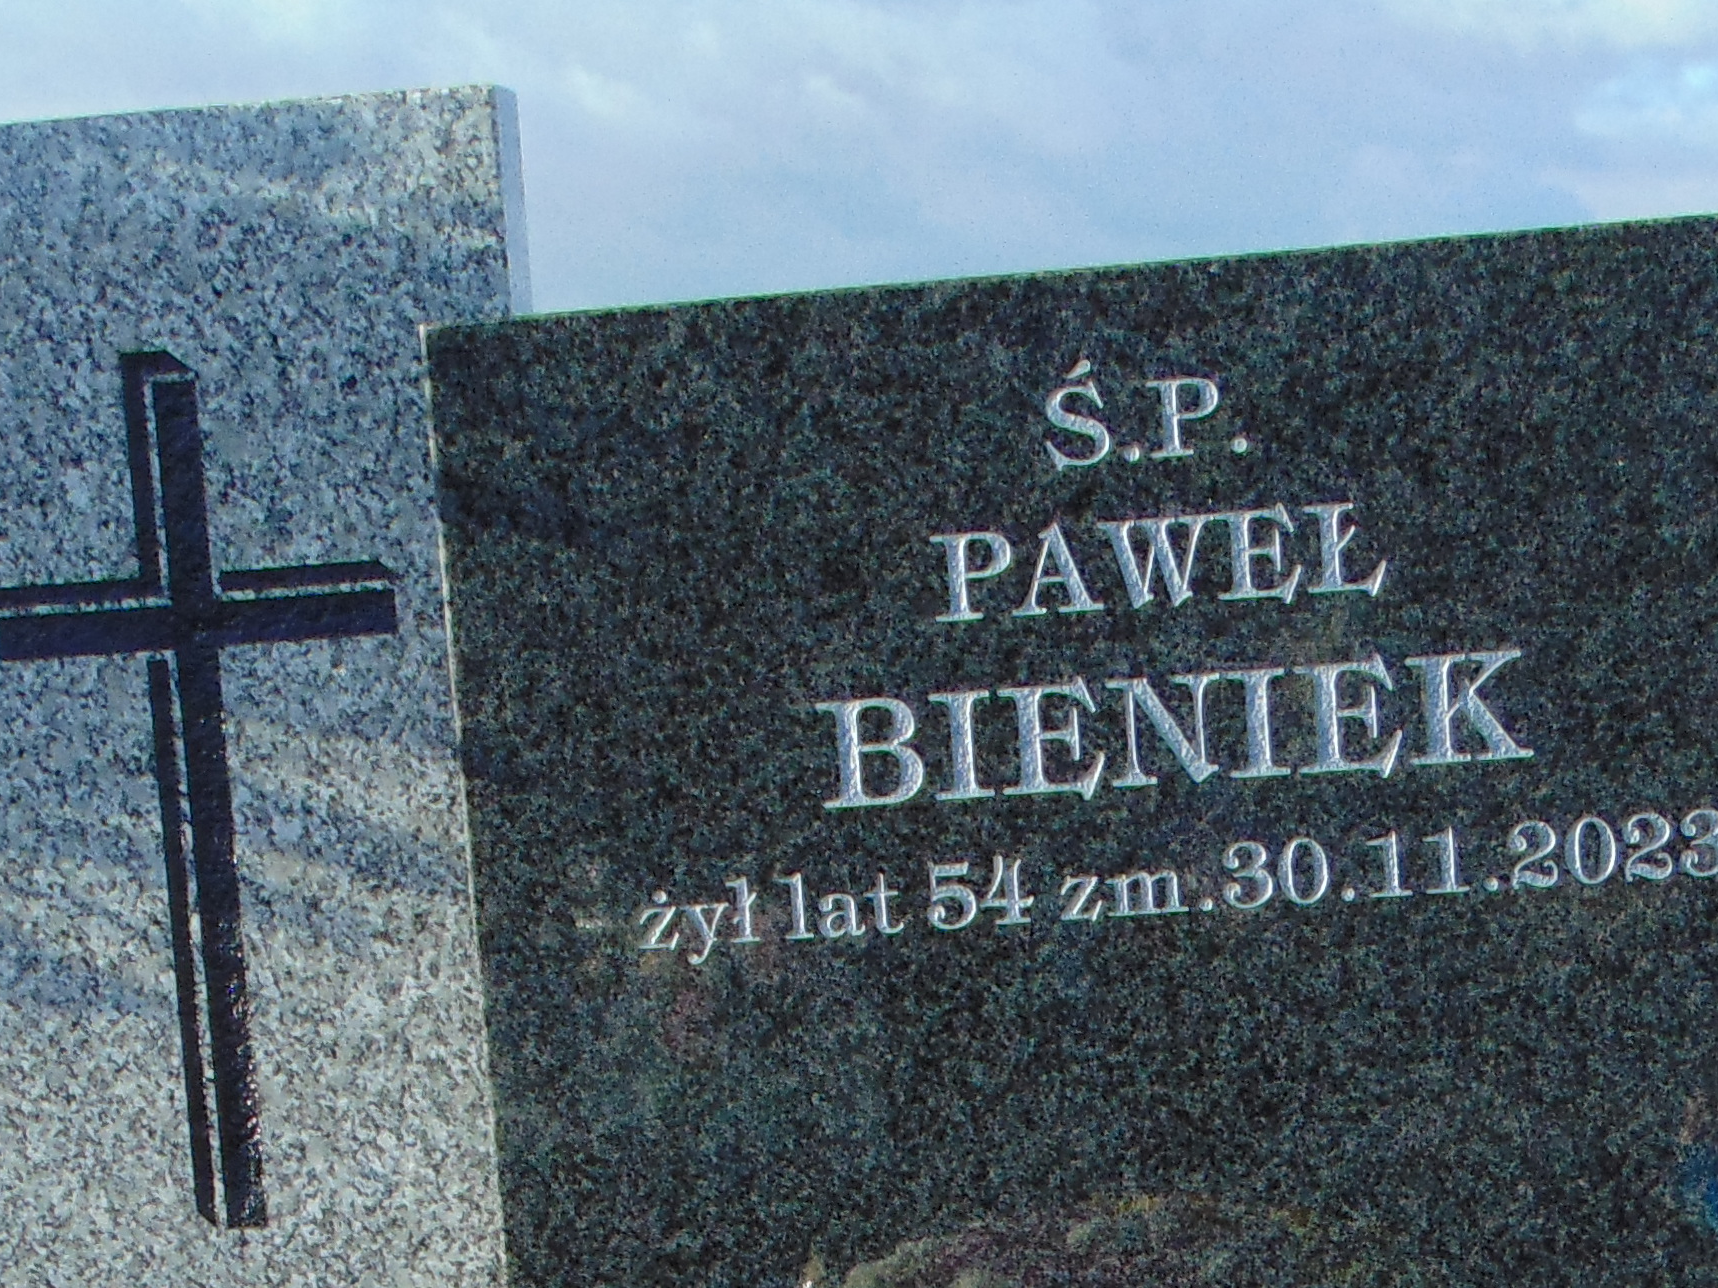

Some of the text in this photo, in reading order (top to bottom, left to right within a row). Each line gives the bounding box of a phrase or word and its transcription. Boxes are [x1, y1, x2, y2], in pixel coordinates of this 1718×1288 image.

[1044, 360, 1251, 472] Ś.P.
[928, 500, 1390, 623] PAWEŁ
[813, 648, 1535, 811] BIENIEK
[637, 877, 761, 966] żył
[785, 870, 905, 942] lat
[926, 854, 1036, 931] 54
